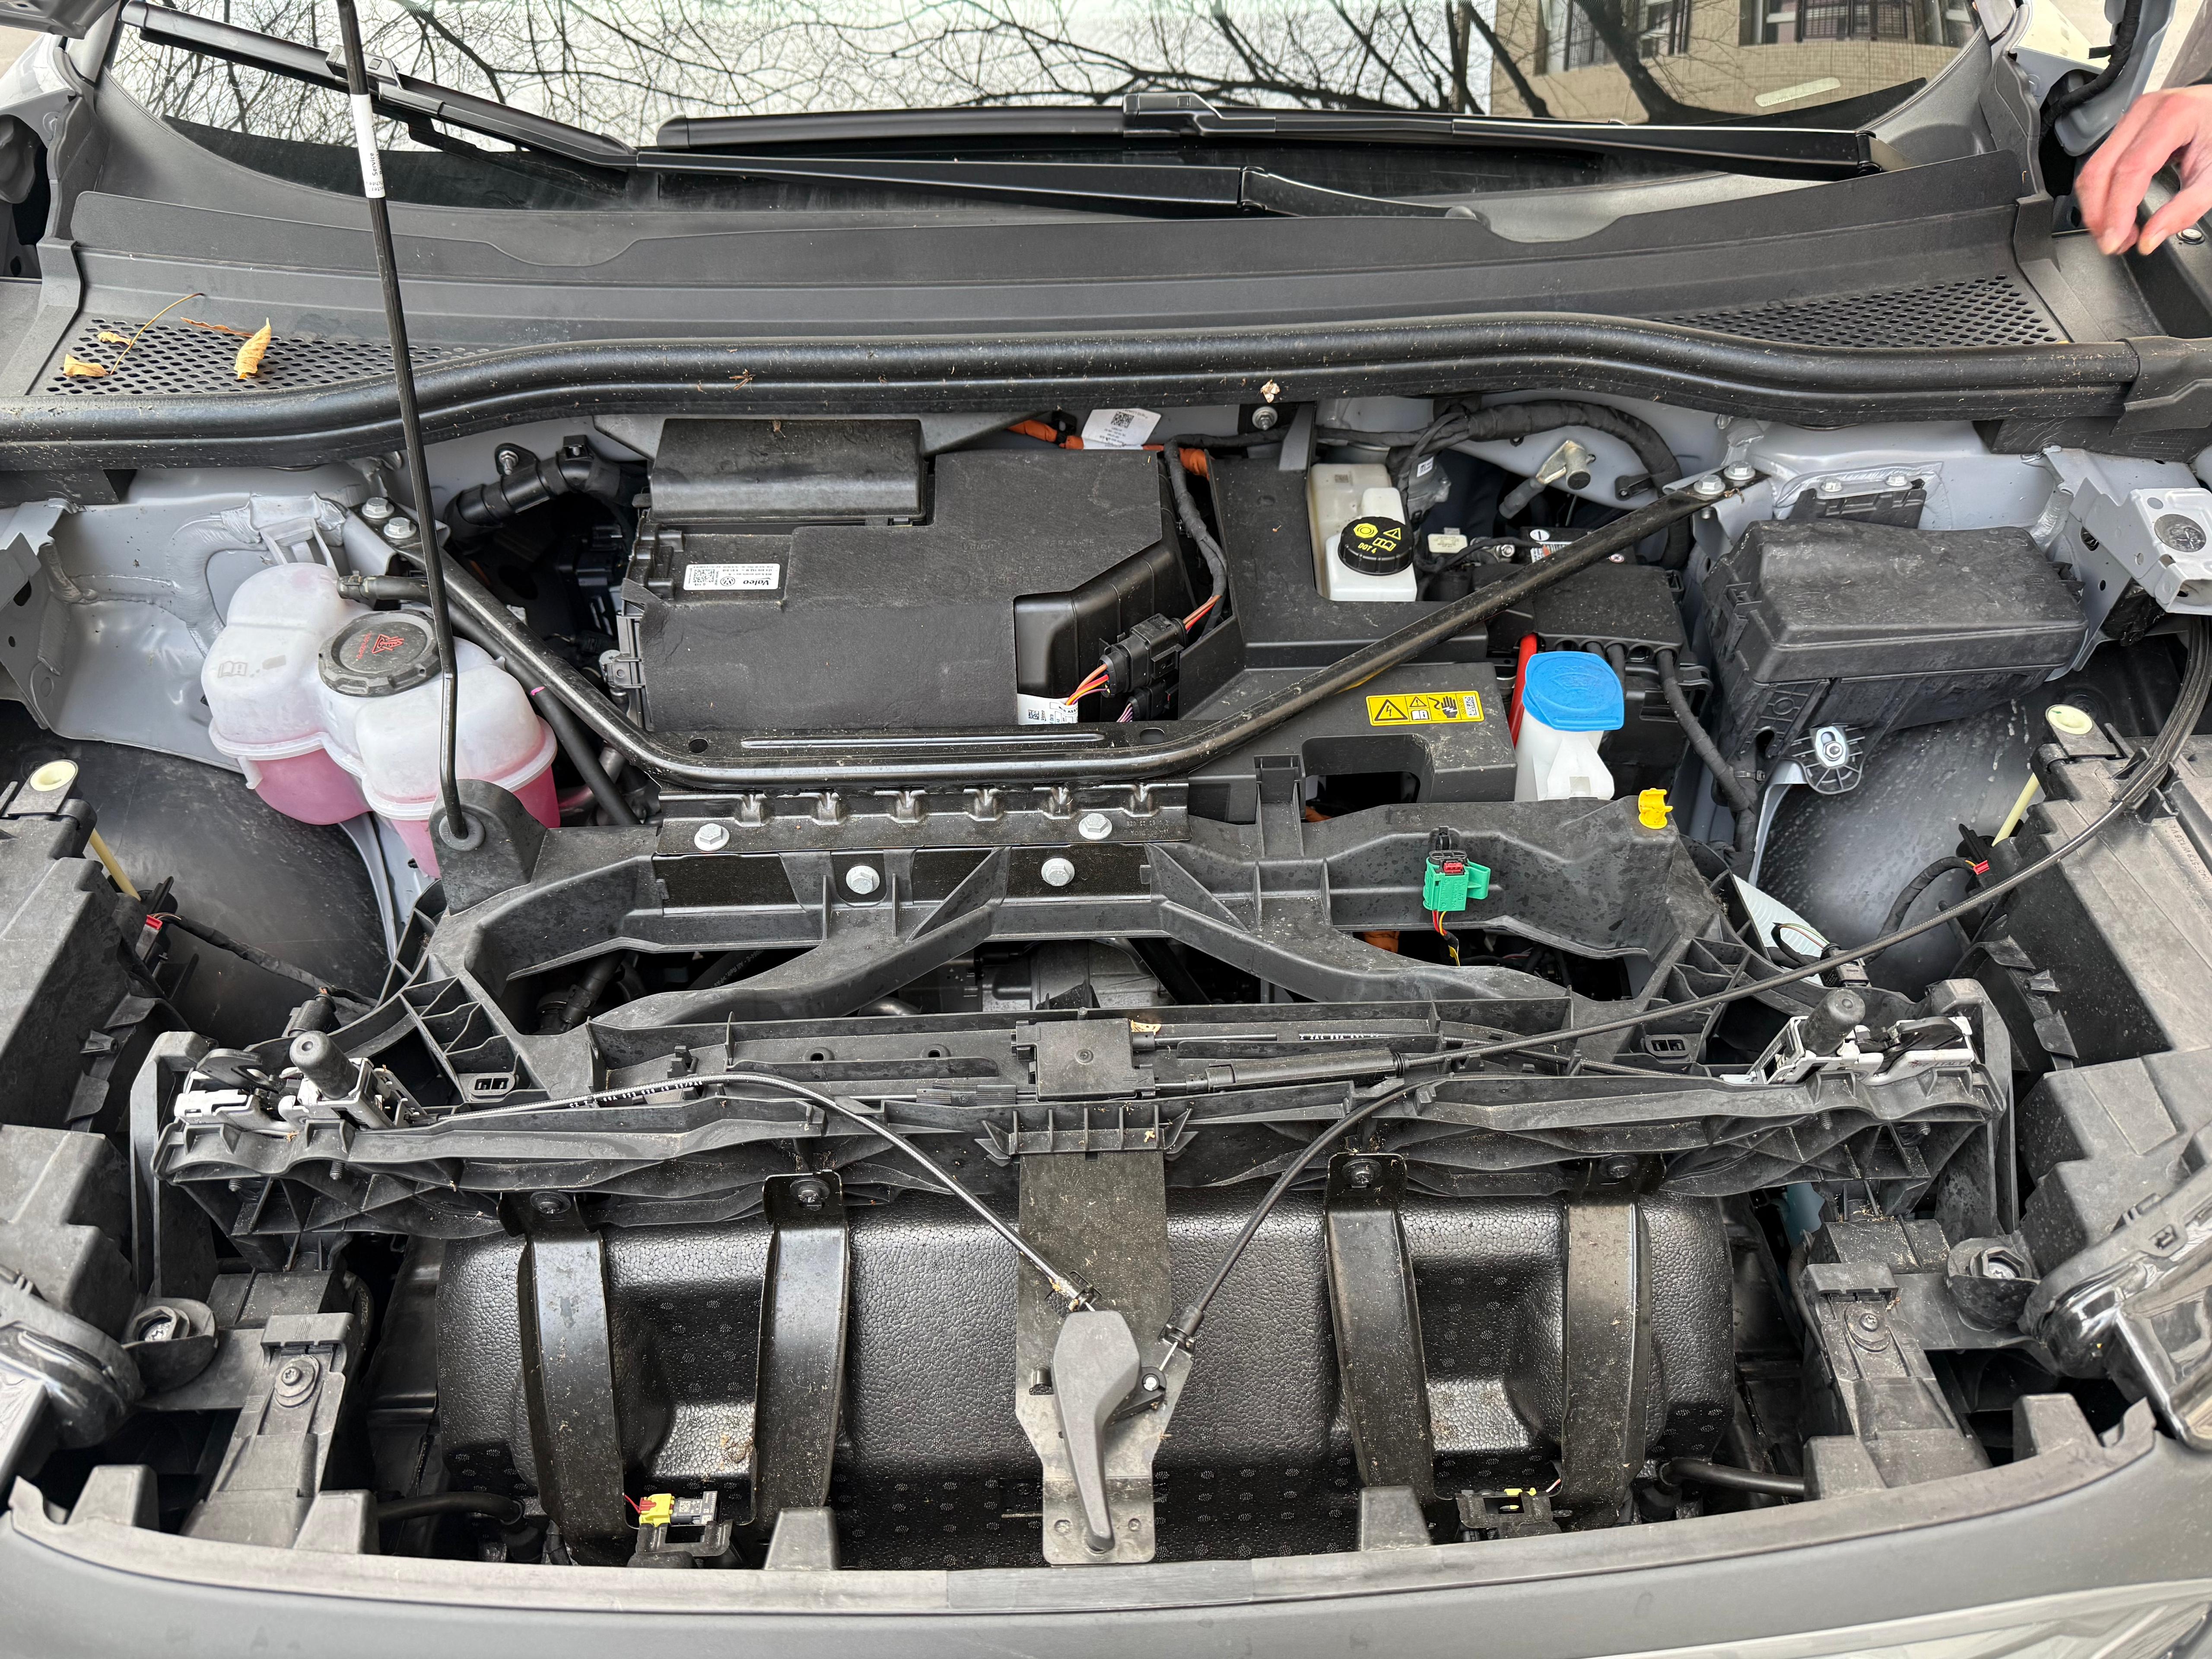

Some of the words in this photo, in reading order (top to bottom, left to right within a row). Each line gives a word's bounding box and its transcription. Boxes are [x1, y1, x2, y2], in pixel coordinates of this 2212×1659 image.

[370, 153, 378, 176] Service
[1357, 542, 1372, 552] DOT
[1459, 881, 1466, 890] VW
[1458, 893, 1465, 901] AG
